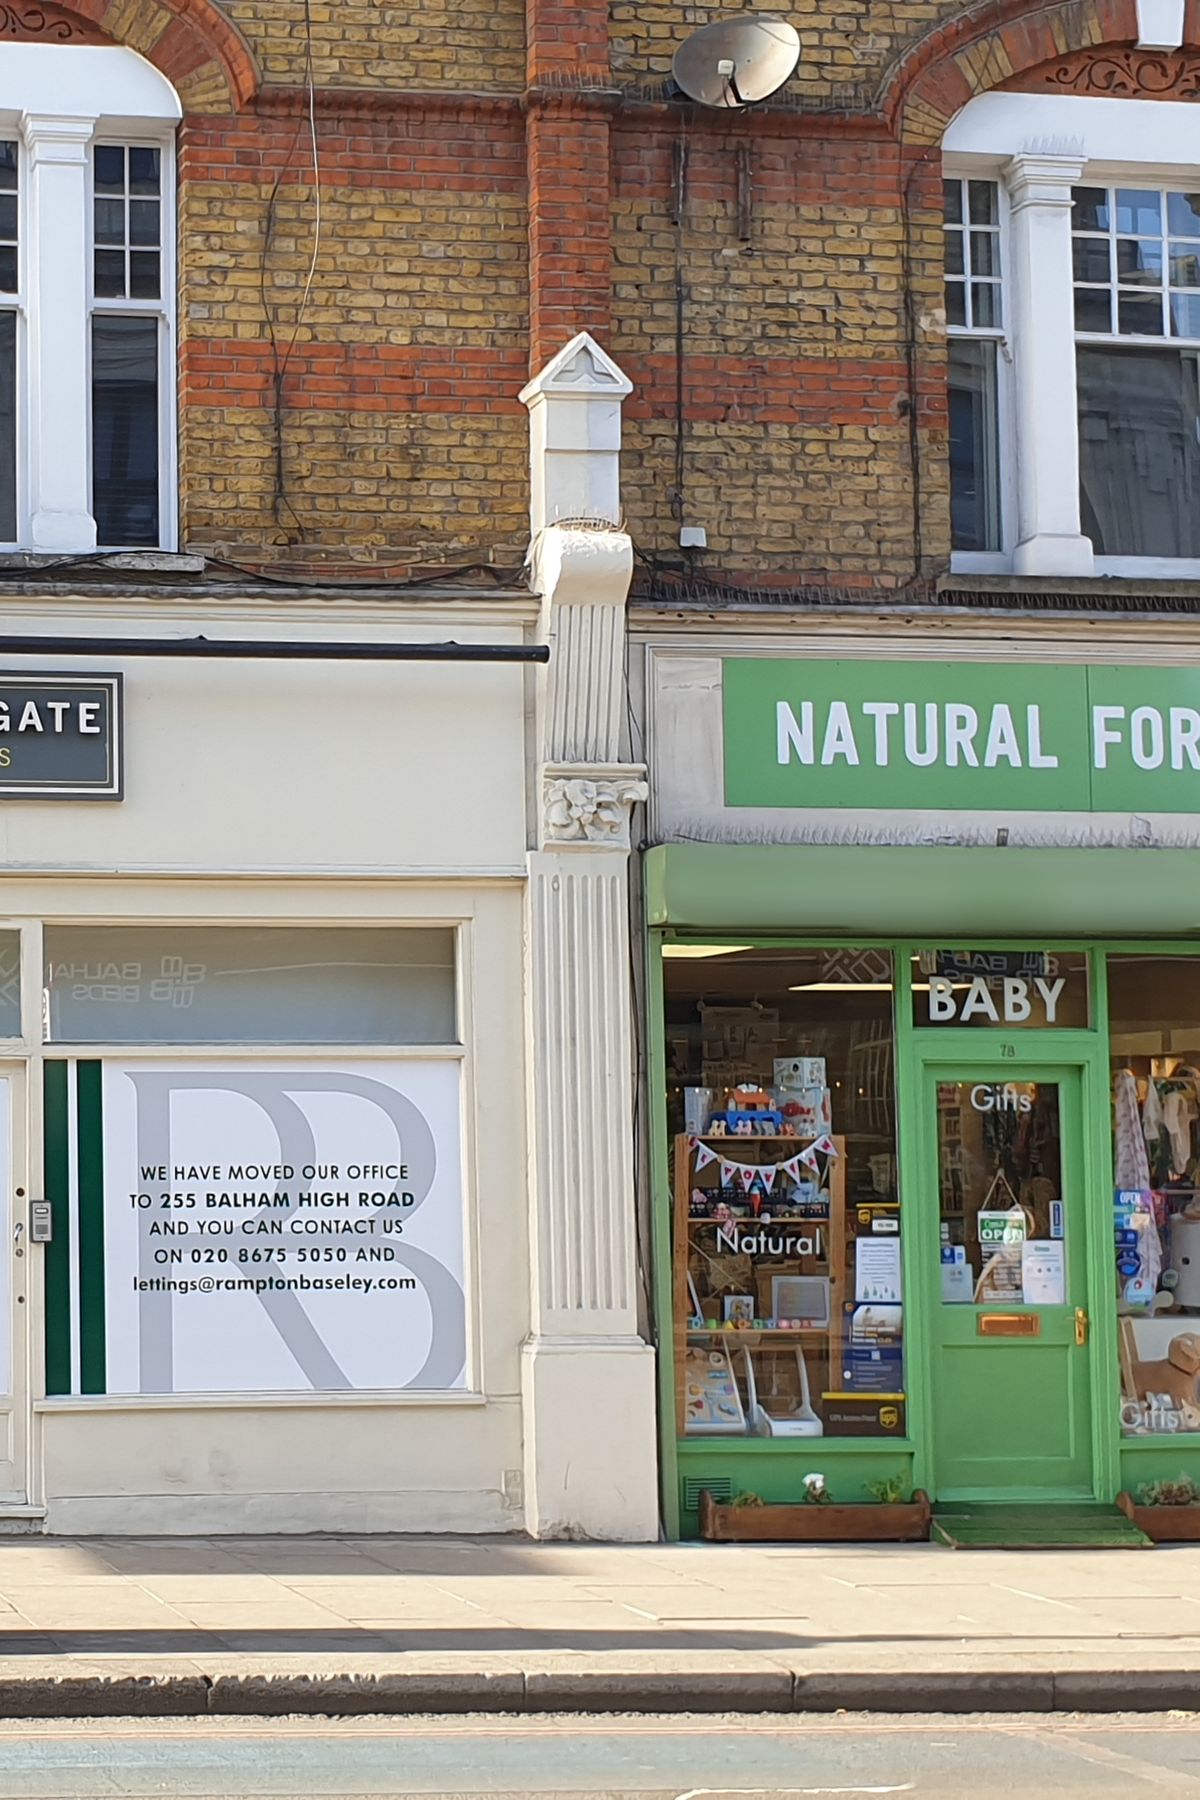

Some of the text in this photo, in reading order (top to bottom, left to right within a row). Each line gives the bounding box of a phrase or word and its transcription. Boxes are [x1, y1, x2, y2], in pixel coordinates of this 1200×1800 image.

[776, 701, 1058, 768] NATURAL
[929, 976, 1066, 1022] BABY
[970, 1082, 1032, 1112] Gifts
[140, 1164, 409, 1180] WE HAVE MOVED OUR OFFICE
[129, 1191, 414, 1209] TO 255 BALHAM HIGH ROAD
[149, 1218, 403, 1236] AND YOU CAN CONTACT US
[716, 1227, 820, 1255] Natural
[154, 1246, 395, 1264] ON 020 8675 5050 AND
[133, 1274, 416, 1294] lettings@ramptonbaseley.com
